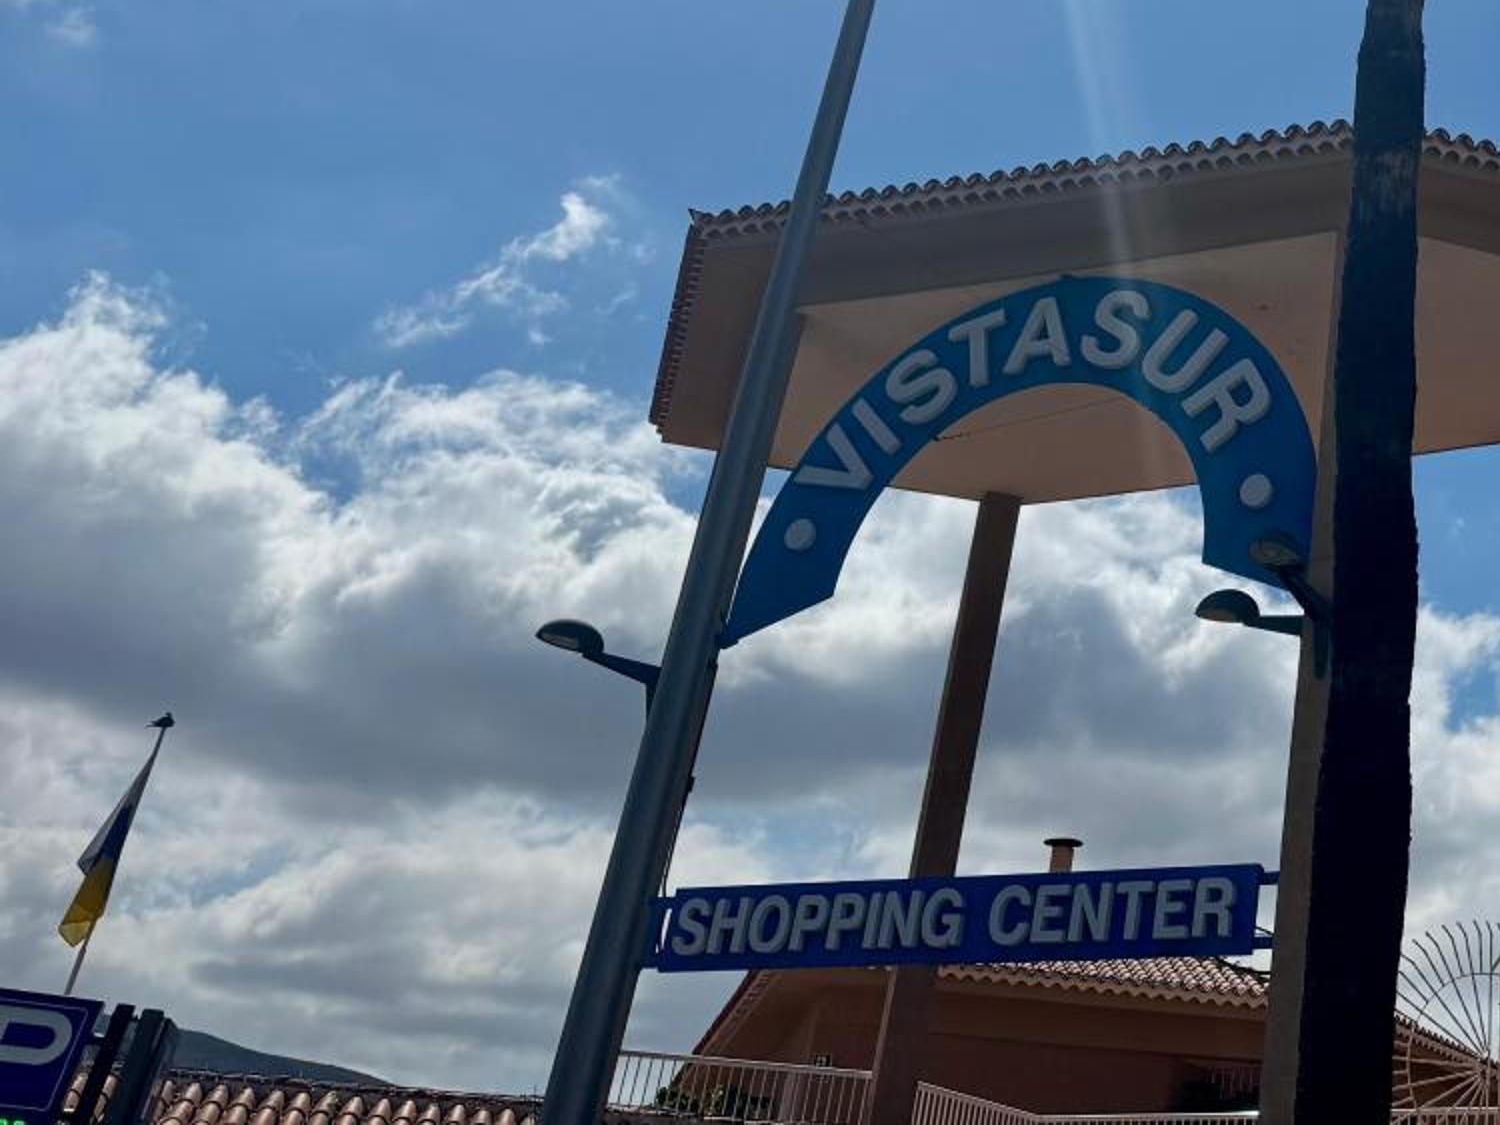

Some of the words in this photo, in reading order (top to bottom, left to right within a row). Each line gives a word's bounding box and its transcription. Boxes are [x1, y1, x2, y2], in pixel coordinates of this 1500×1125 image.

[794, 290, 1272, 491] VISTASUR
[672, 887, 963, 955] SHOPPING
[988, 877, 1236, 946] CENTER
